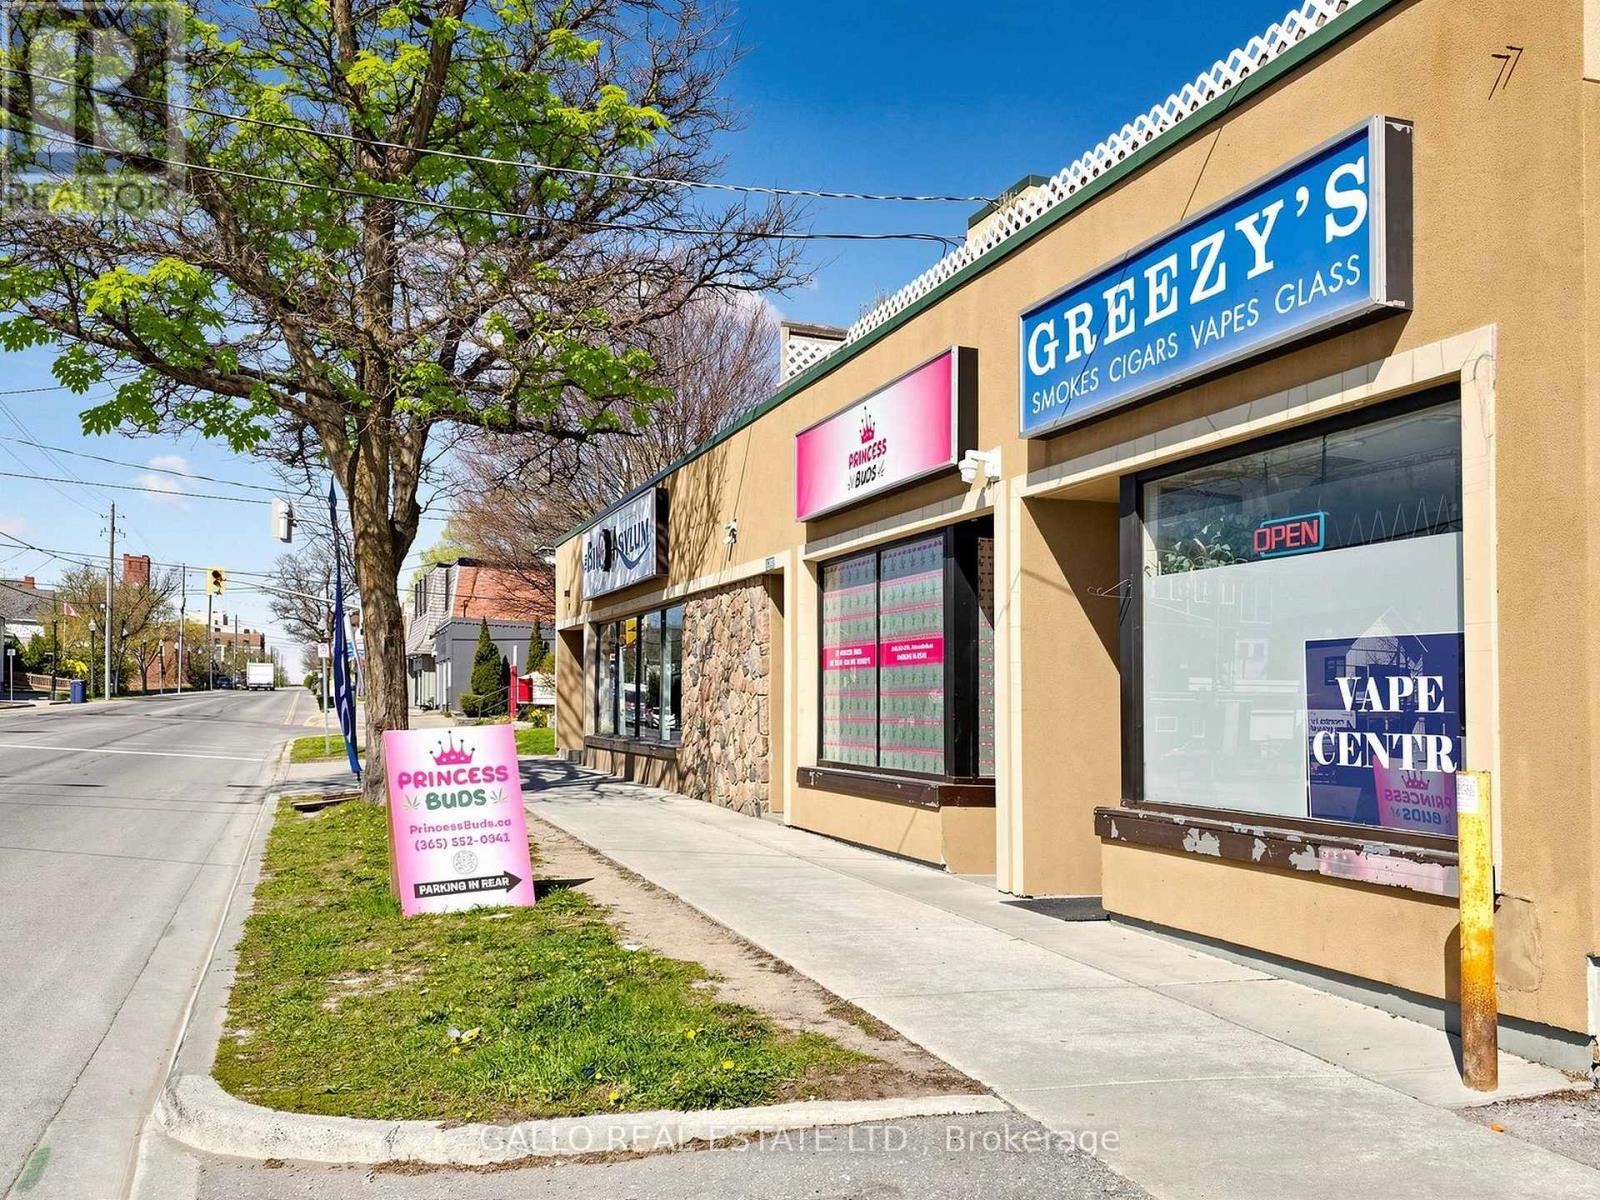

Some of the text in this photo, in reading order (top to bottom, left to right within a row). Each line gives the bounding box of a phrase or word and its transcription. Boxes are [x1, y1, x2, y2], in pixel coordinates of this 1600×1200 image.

[1028, 156, 1368, 376] GREEZY'S
[1032, 254, 1361, 414] SMOKES CIGARS VAPES GLASS
[848, 438, 887, 469] PRINCESS
[855, 464, 876, 488] BUDS
[1253, 519, 1319, 553] OPEN
[1335, 675, 1445, 713] VAPE
[1312, 731, 1466, 773] CENTR
[398, 765, 509, 789] PRINCESS
[425, 788, 487, 811] BUDS
[414, 837, 448, 851] (365)
[418, 877, 510, 895] PARKING IN REAR
